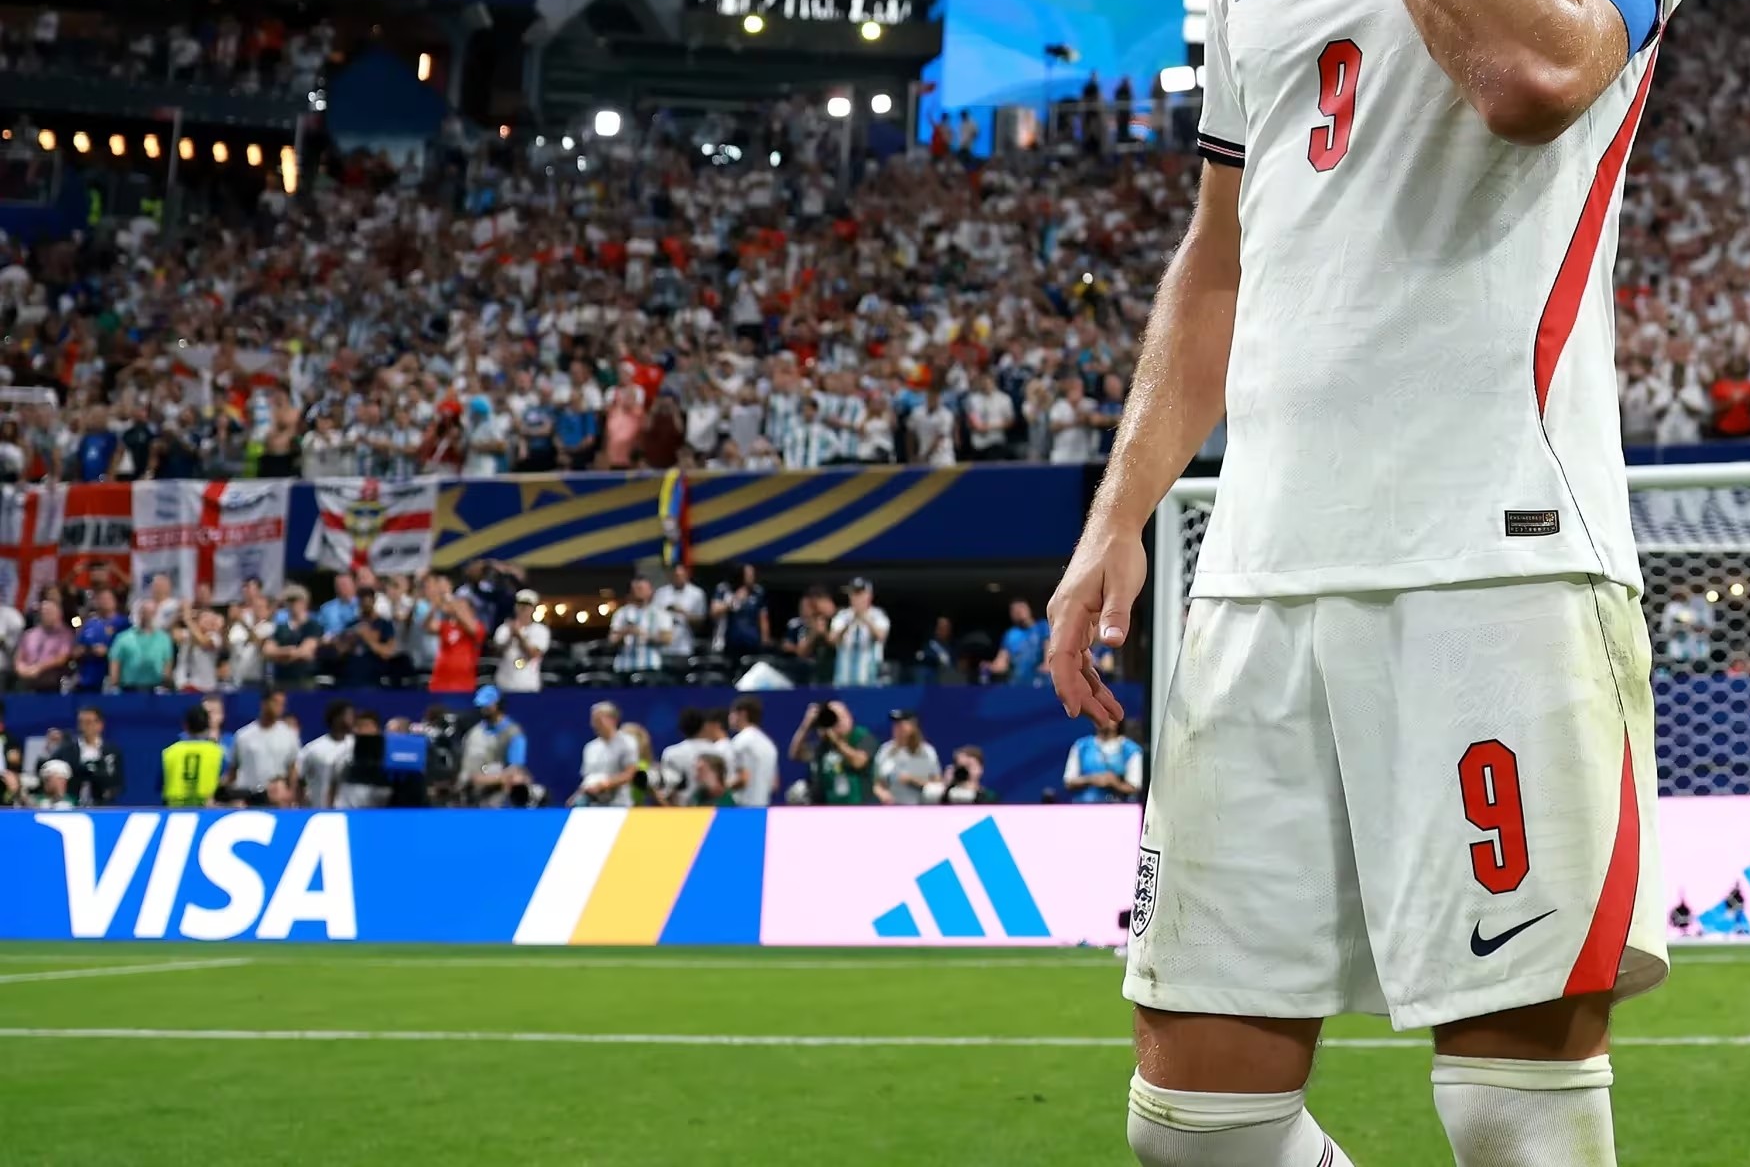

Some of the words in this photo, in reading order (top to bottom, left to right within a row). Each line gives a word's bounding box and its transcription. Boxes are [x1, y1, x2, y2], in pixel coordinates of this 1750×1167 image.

[1307, 38, 1363, 173] 9
[35, 811, 358, 940] VISA
[1457, 738, 1531, 895] 9
